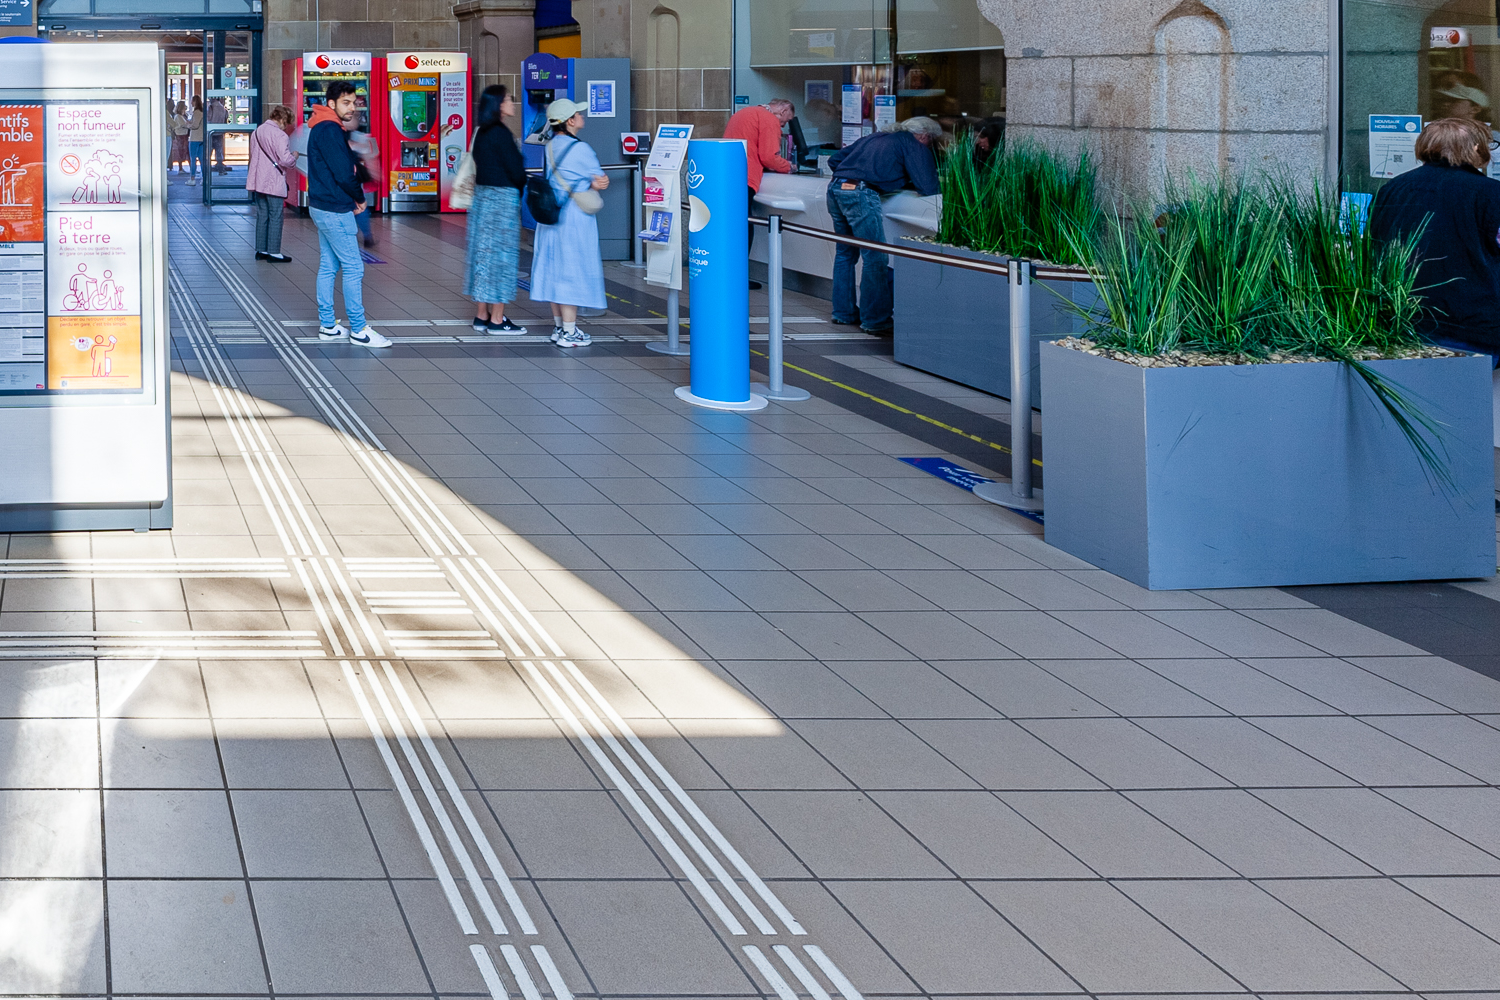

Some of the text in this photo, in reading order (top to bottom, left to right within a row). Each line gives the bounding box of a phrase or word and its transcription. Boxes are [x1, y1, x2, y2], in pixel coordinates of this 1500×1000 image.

[390, 77, 400, 87] ICI
[419, 77, 436, 86] MINIS
[58, 107, 101, 118] Espace
[58, 120, 126, 131] non fumeur
[59, 216, 93, 230] Pied
[59, 231, 110, 244] à terre
